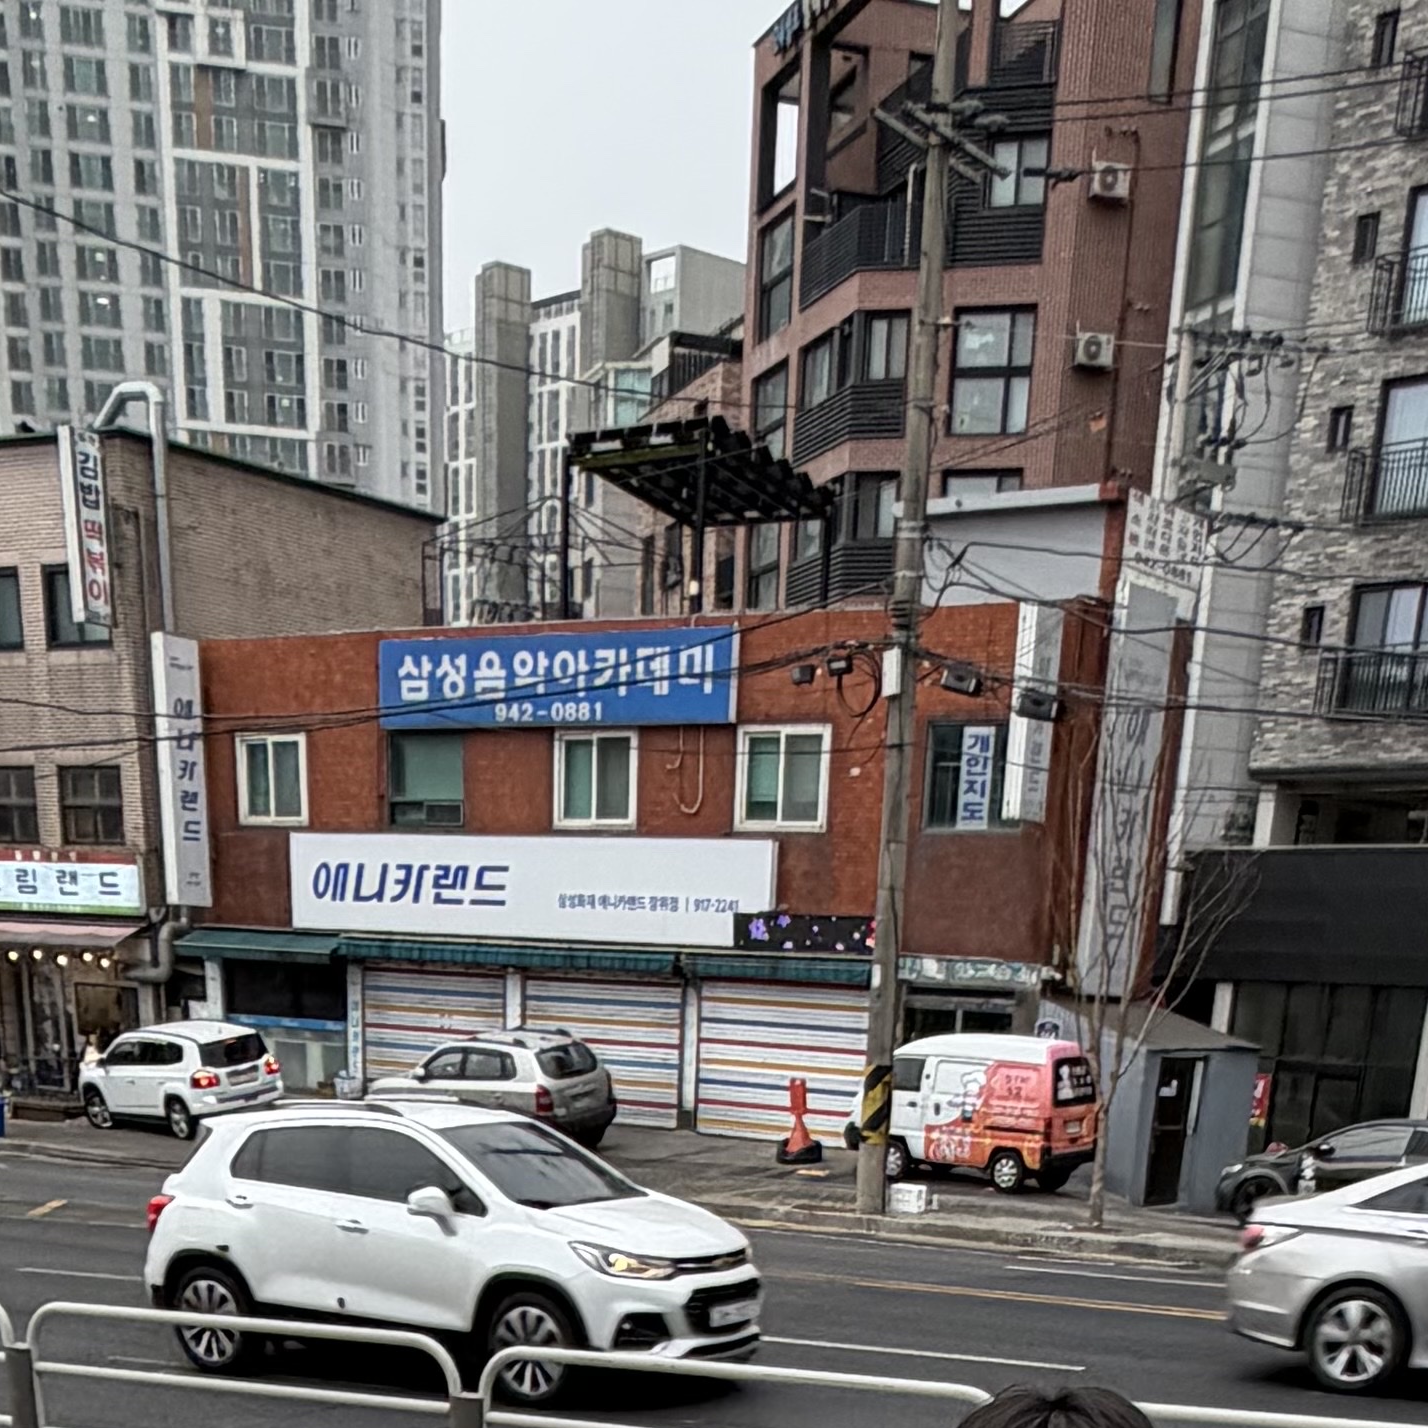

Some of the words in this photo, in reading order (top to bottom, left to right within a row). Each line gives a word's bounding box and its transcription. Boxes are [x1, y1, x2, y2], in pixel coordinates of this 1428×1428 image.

[397, 643, 715, 701] 삼성음악아카데미
[494, 701, 603, 722] 942-0881
[961, 734, 990, 822] 개인지도
[312, 862, 510, 906] 애니카랜드
